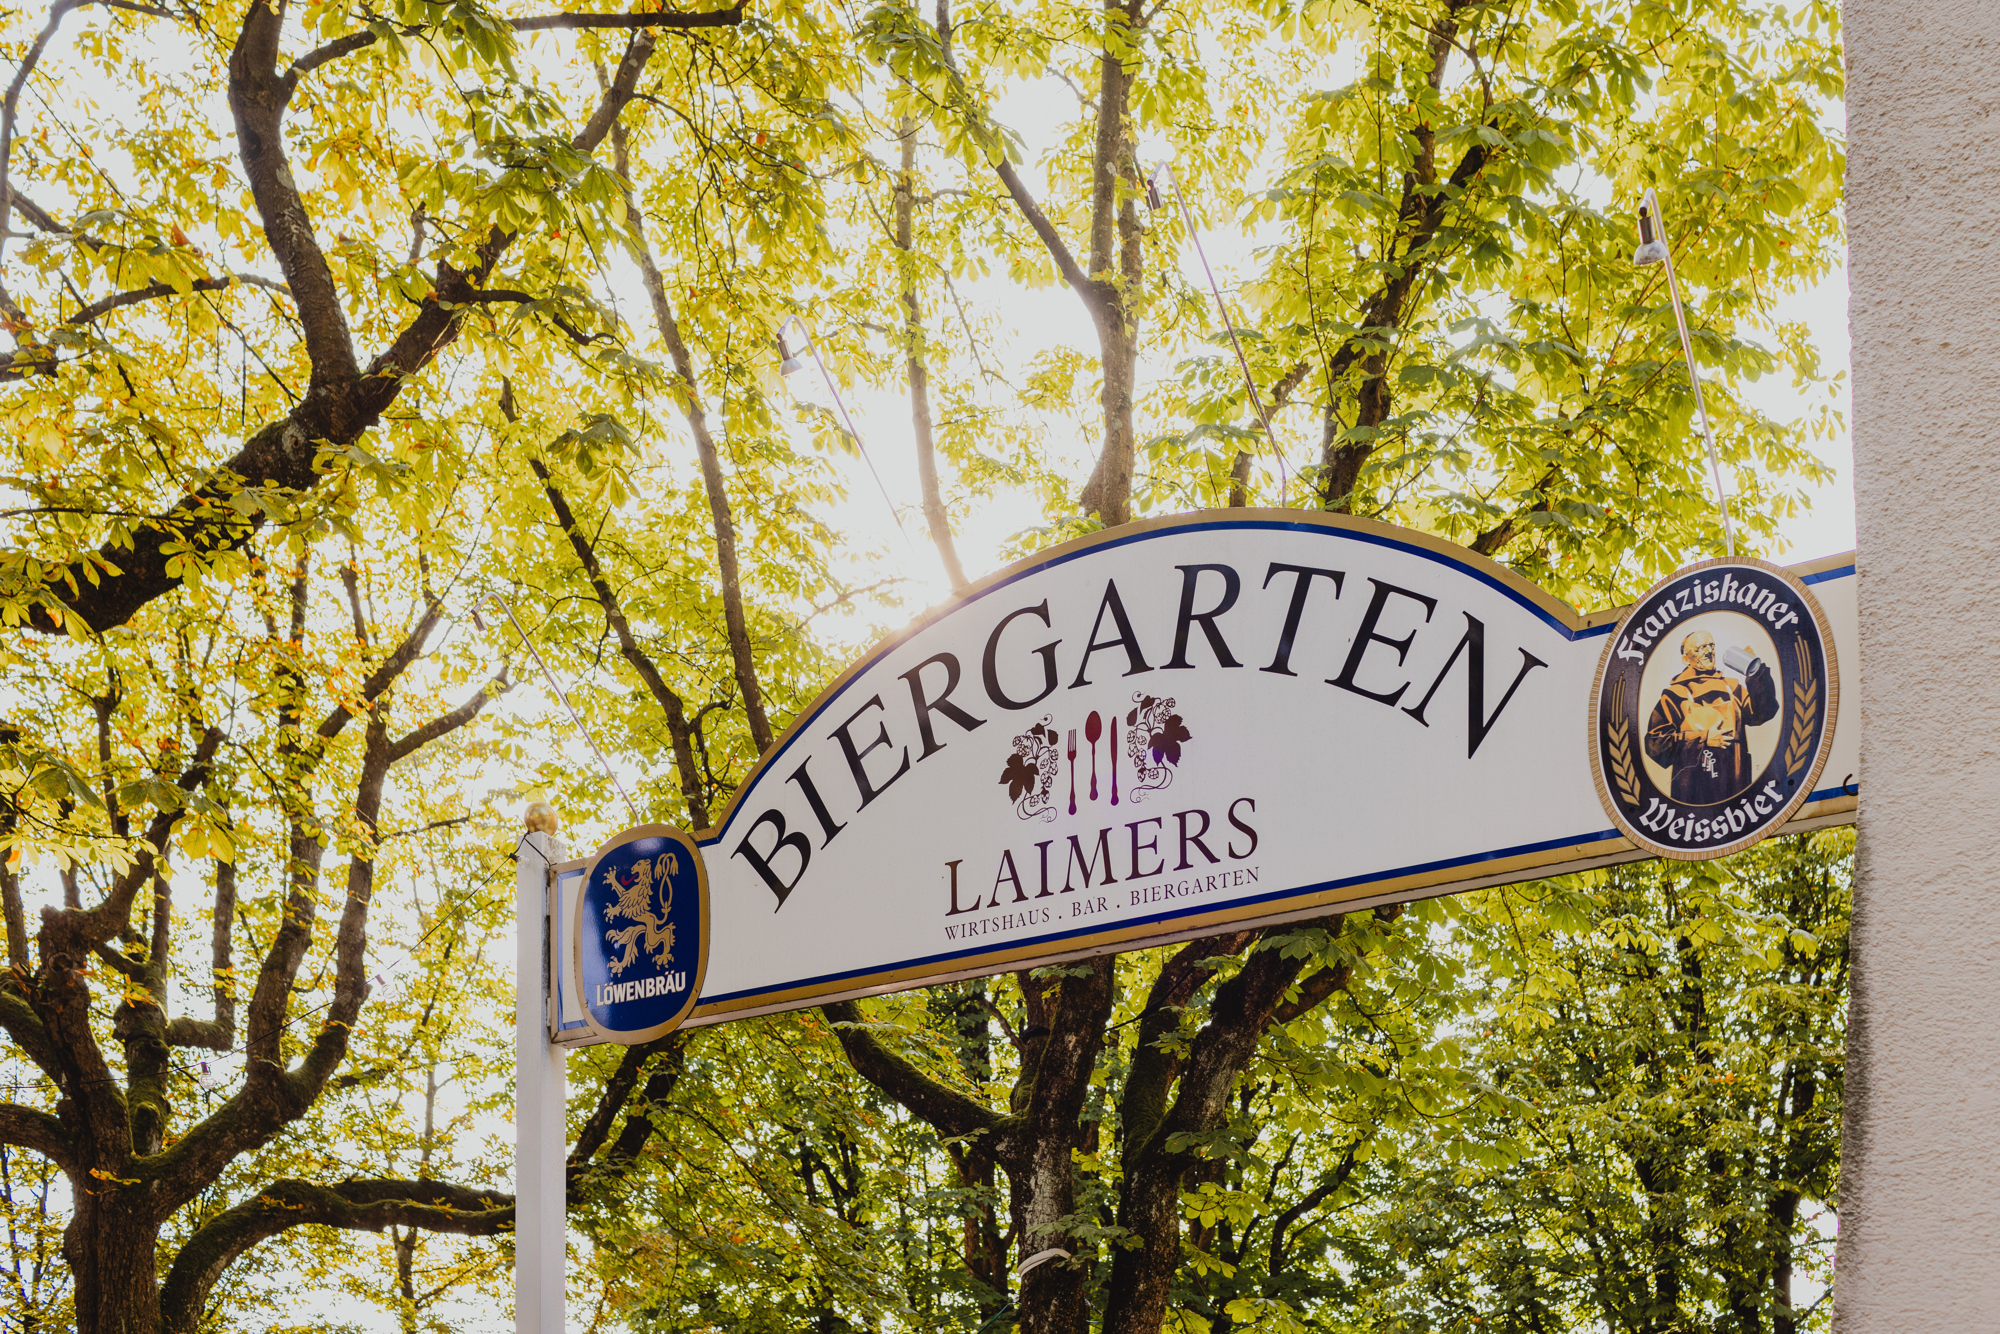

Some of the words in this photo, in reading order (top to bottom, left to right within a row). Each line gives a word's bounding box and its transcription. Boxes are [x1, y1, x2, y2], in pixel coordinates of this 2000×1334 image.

[1616, 572, 1799, 666] Franziskaner
[730, 562, 1549, 914] BIERGARTEN
[1638, 779, 1784, 842] Weissbier
[944, 797, 1259, 917] LAIMERS
[944, 907, 1051, 941] WIRTSHAUS
[1071, 896, 1109, 917] BAR
[1129, 866, 1261, 906] BIERGARTEN
[596, 970, 687, 1007] LÖWENBRÄU
